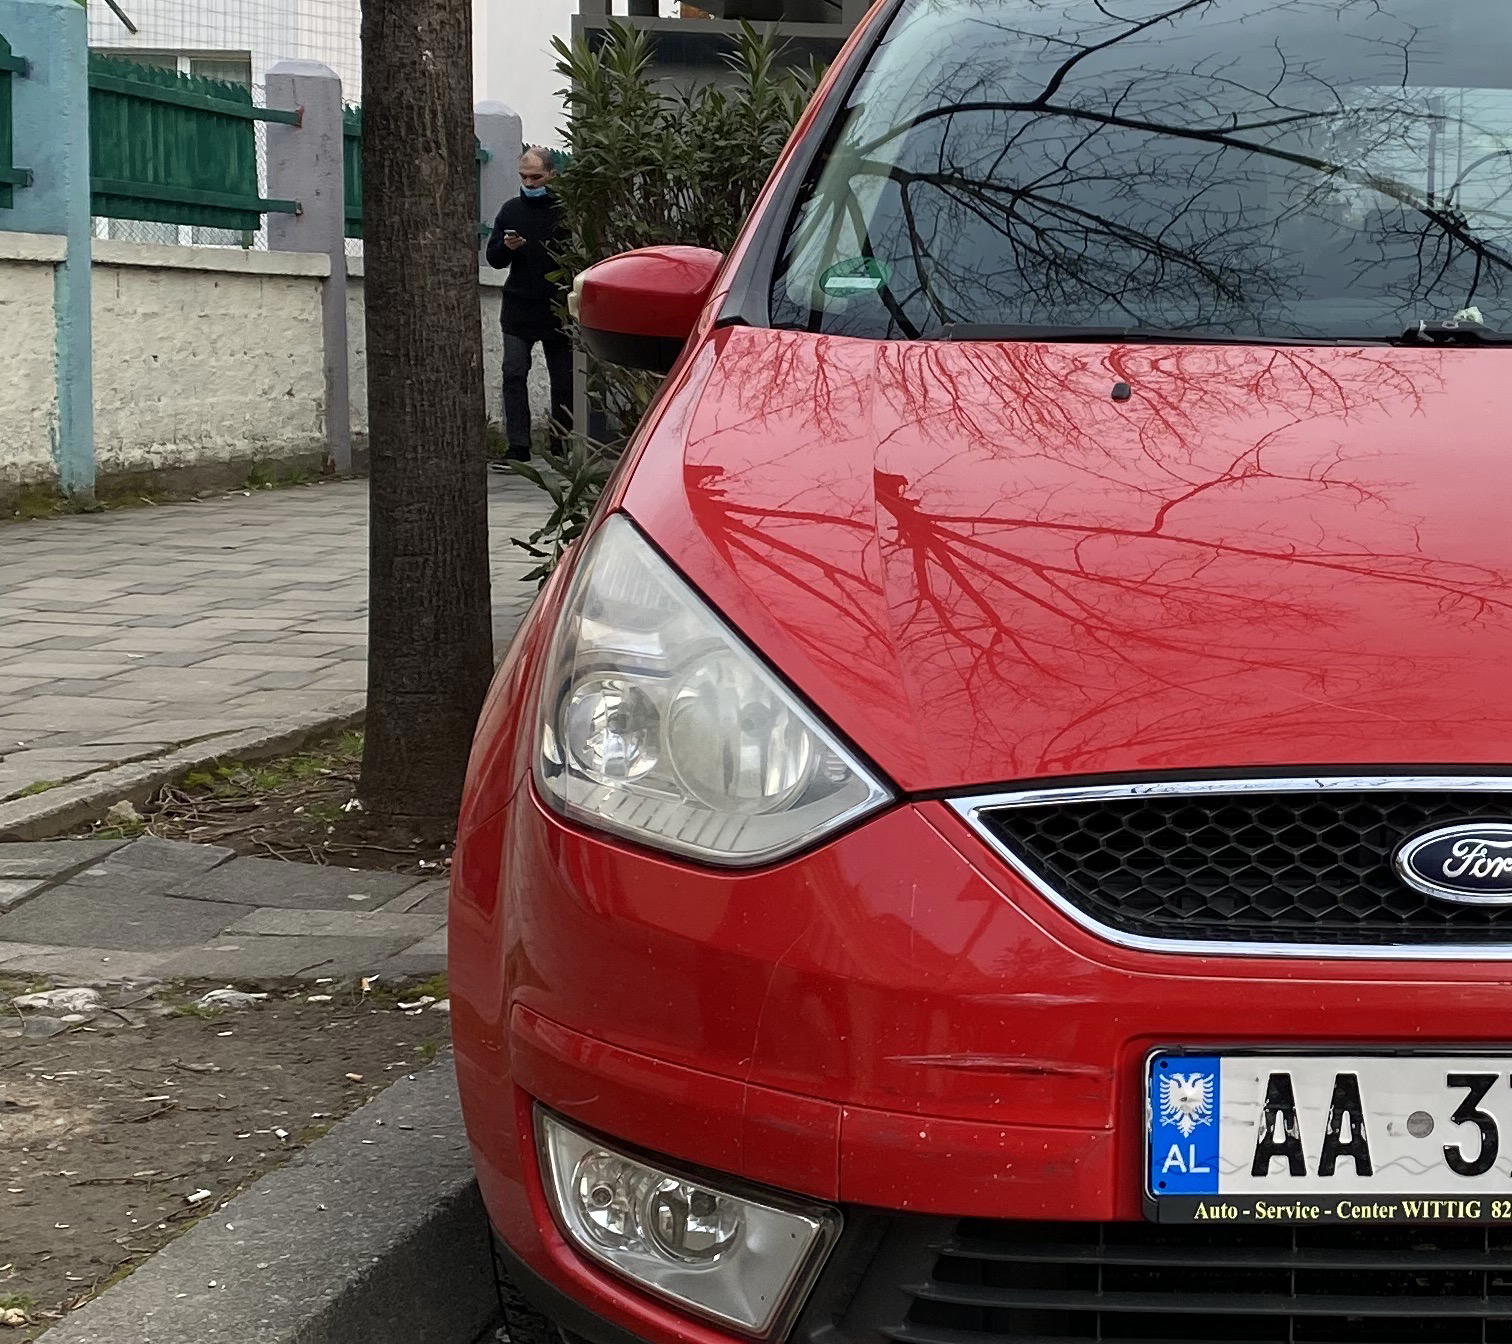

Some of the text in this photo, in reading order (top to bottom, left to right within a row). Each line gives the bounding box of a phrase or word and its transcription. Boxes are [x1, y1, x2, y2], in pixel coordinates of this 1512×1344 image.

[1251, 1072, 1374, 1177] AA
[1161, 1143, 1211, 1174] AL
[1193, 1200, 1239, 1220] Auto
[1255, 1200, 1320, 1220] Service
[1336, 1200, 1398, 1220] Center
[1401, 1200, 1481, 1219] WITTIG
